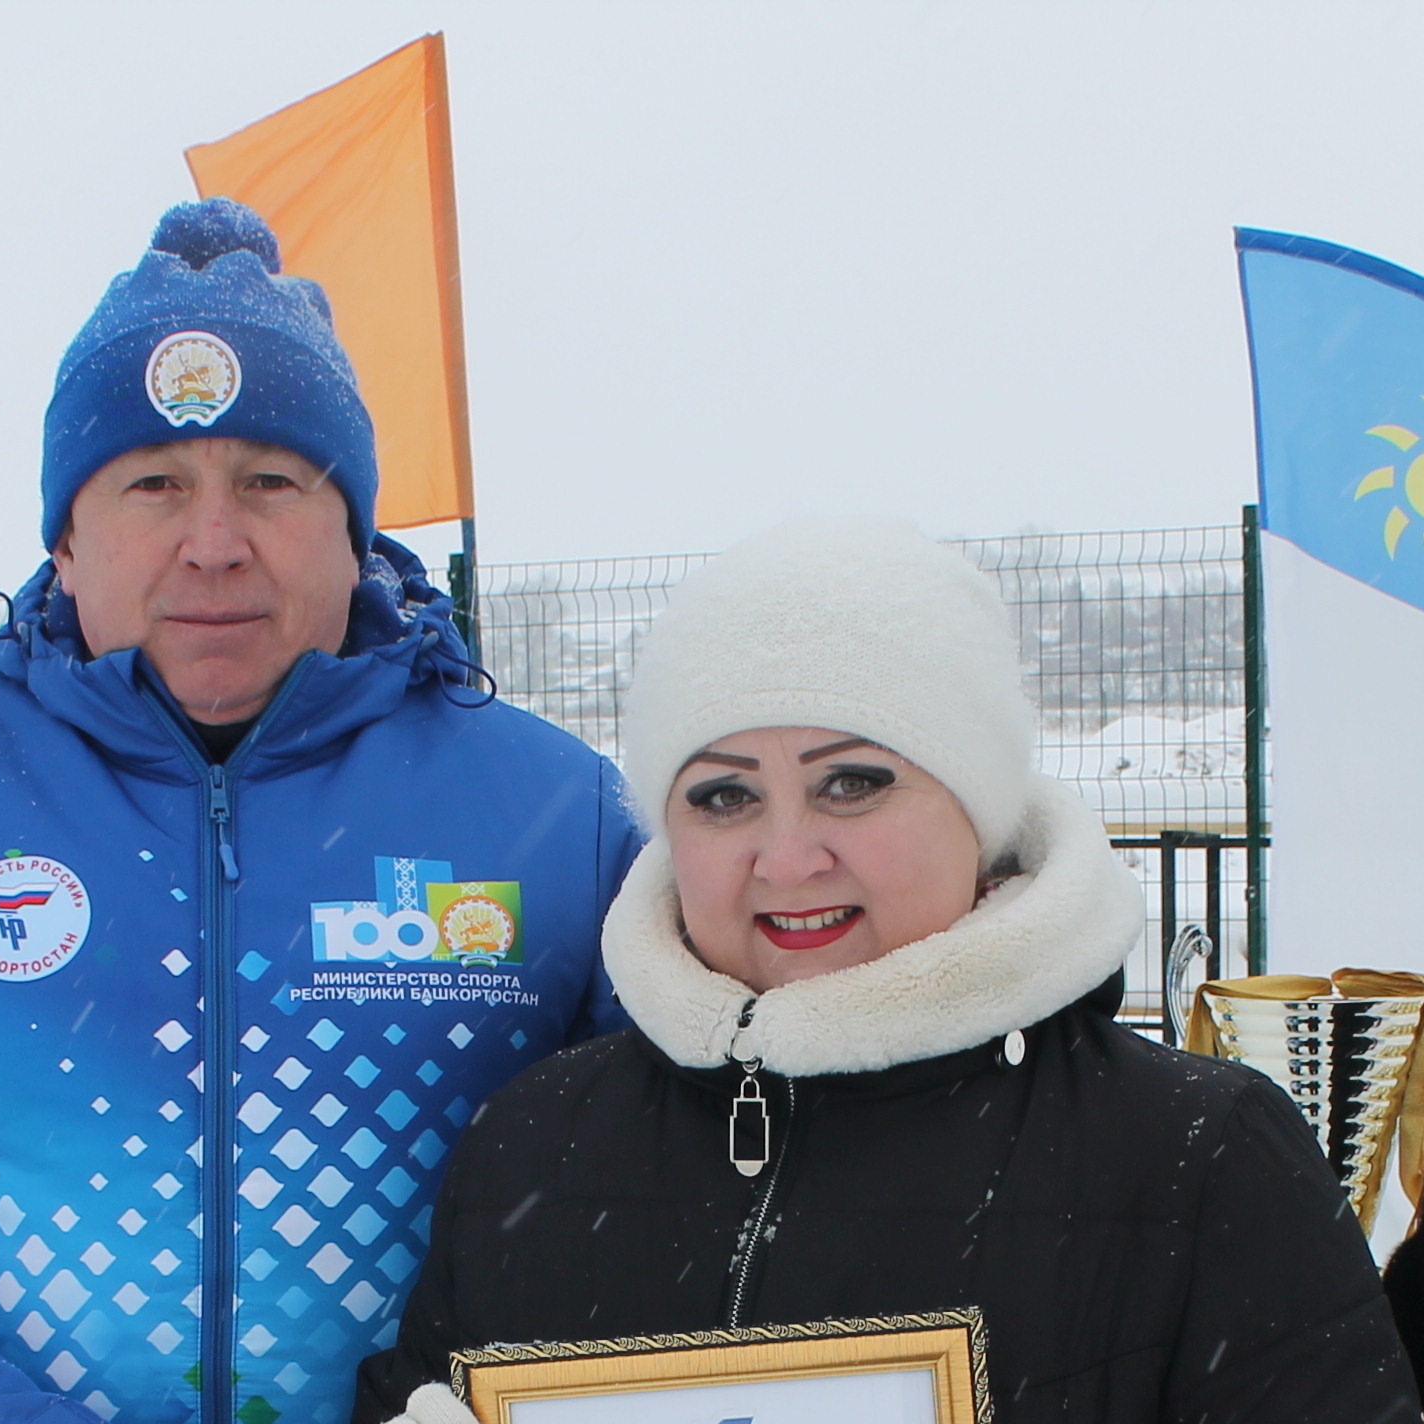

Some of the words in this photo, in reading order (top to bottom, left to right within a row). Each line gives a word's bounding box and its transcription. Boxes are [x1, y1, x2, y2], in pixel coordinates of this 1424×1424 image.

[314, 908, 439, 960] 100
[313, 972, 452, 986] МИНИСТЕРСТВО
[457, 974, 521, 988] СПОРТА
[290, 987, 405, 1001] РЕСПУБЛИКИ
[410, 988, 539, 1006] БАШКОРТОСТАН
